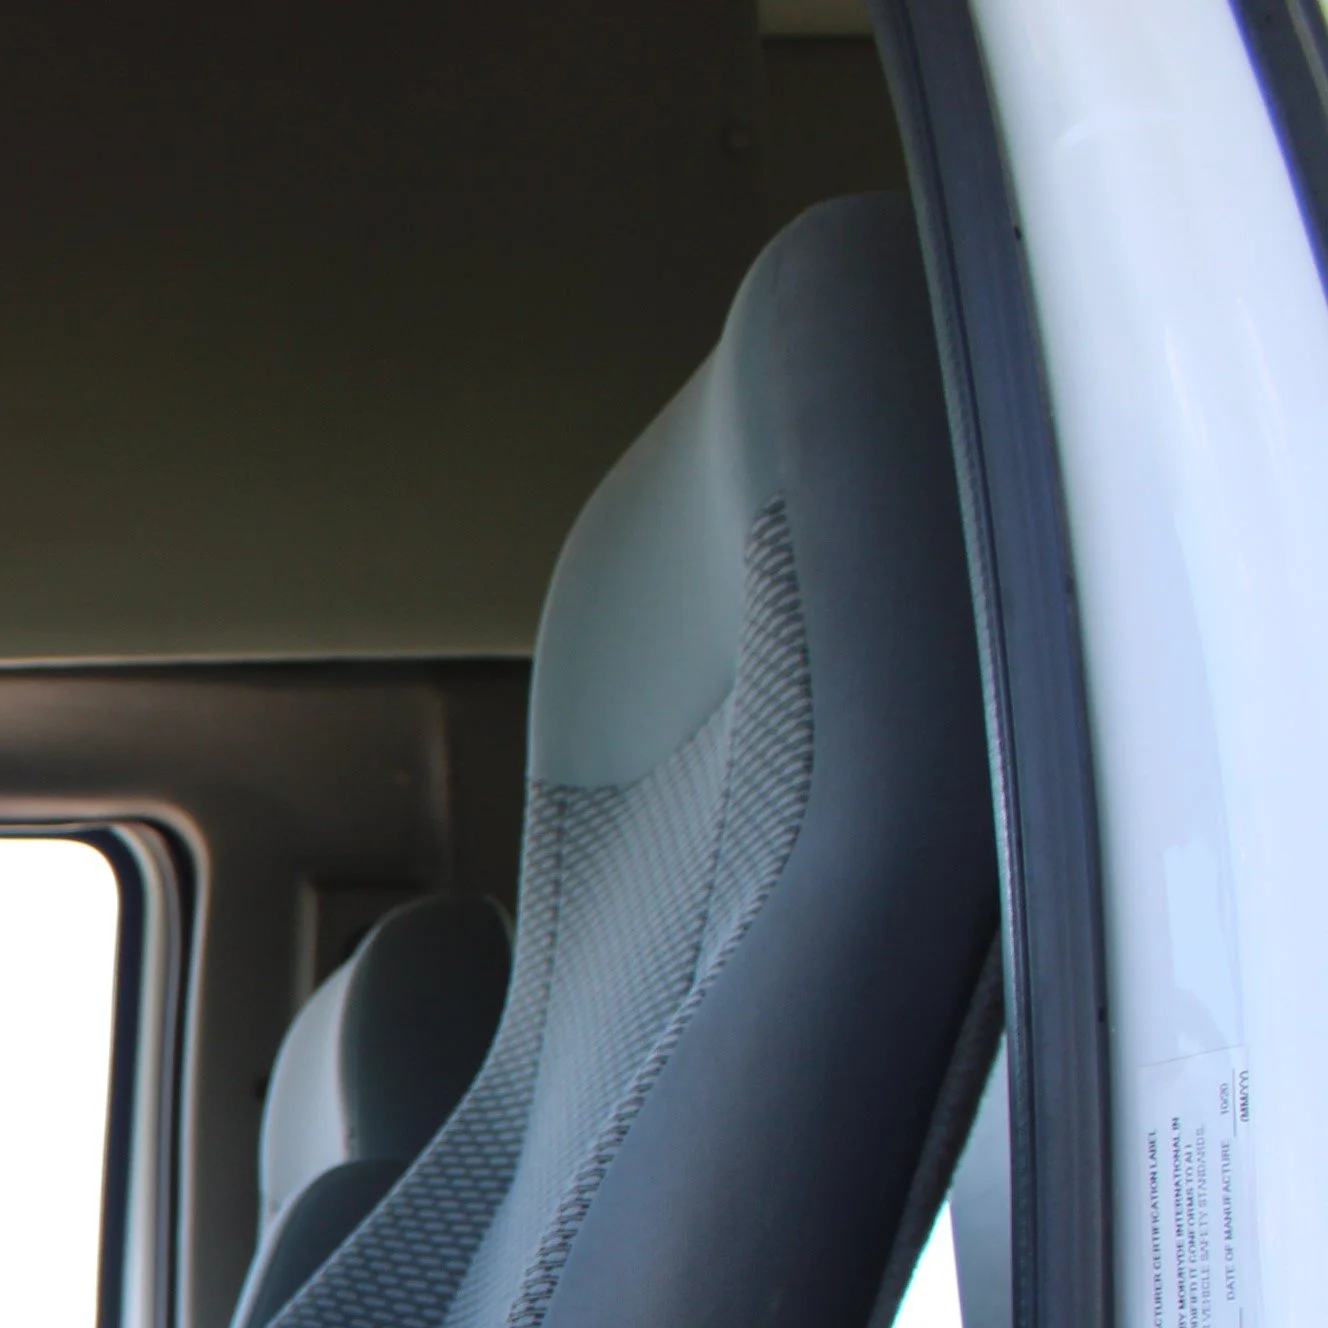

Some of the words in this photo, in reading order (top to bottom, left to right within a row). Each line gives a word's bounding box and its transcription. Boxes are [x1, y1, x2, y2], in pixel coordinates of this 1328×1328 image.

[1148, 1129, 1157, 1168] LABEL
[1172, 1117, 1180, 1131] IN
[1172, 1134, 1185, 1237] INTERNATIONAL
[1185, 1167, 1194, 1184] TO
[1221, 1140, 1233, 1240] MANUFACTURE
[1149, 1171, 1162, 1270] CERTIFICATION
[1186, 1188, 1196, 1263] CONFORMS
[1198, 1211, 1209, 1261] SAFETY
[1225, 1244, 1234, 1261] OF
[1200, 1266, 1211, 1321] VEHICLE
[1225, 1266, 1235, 1300] DATE
